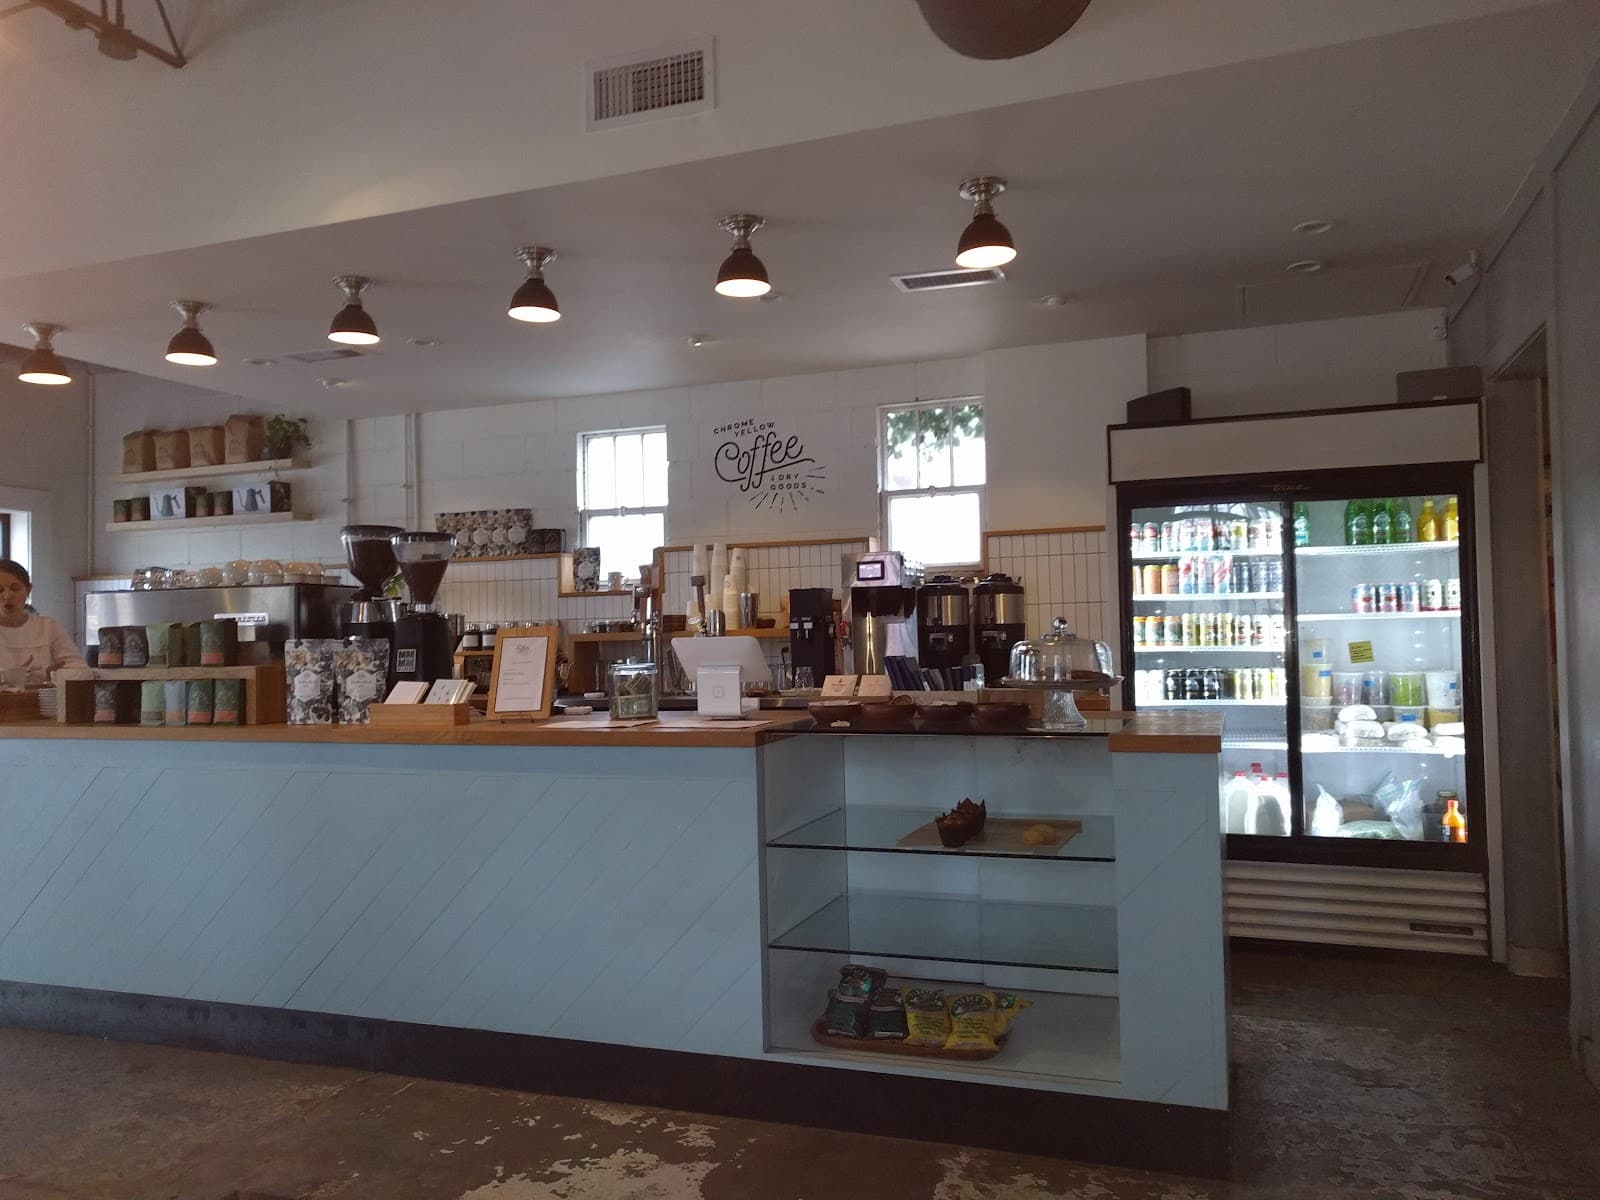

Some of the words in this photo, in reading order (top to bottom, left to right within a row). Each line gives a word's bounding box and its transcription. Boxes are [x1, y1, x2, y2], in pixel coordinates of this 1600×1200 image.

[713, 418, 755, 435] CHROME
[734, 421, 776, 438] YELLOW
[714, 431, 815, 492] Coffee
[770, 482, 807, 491] GOODS
